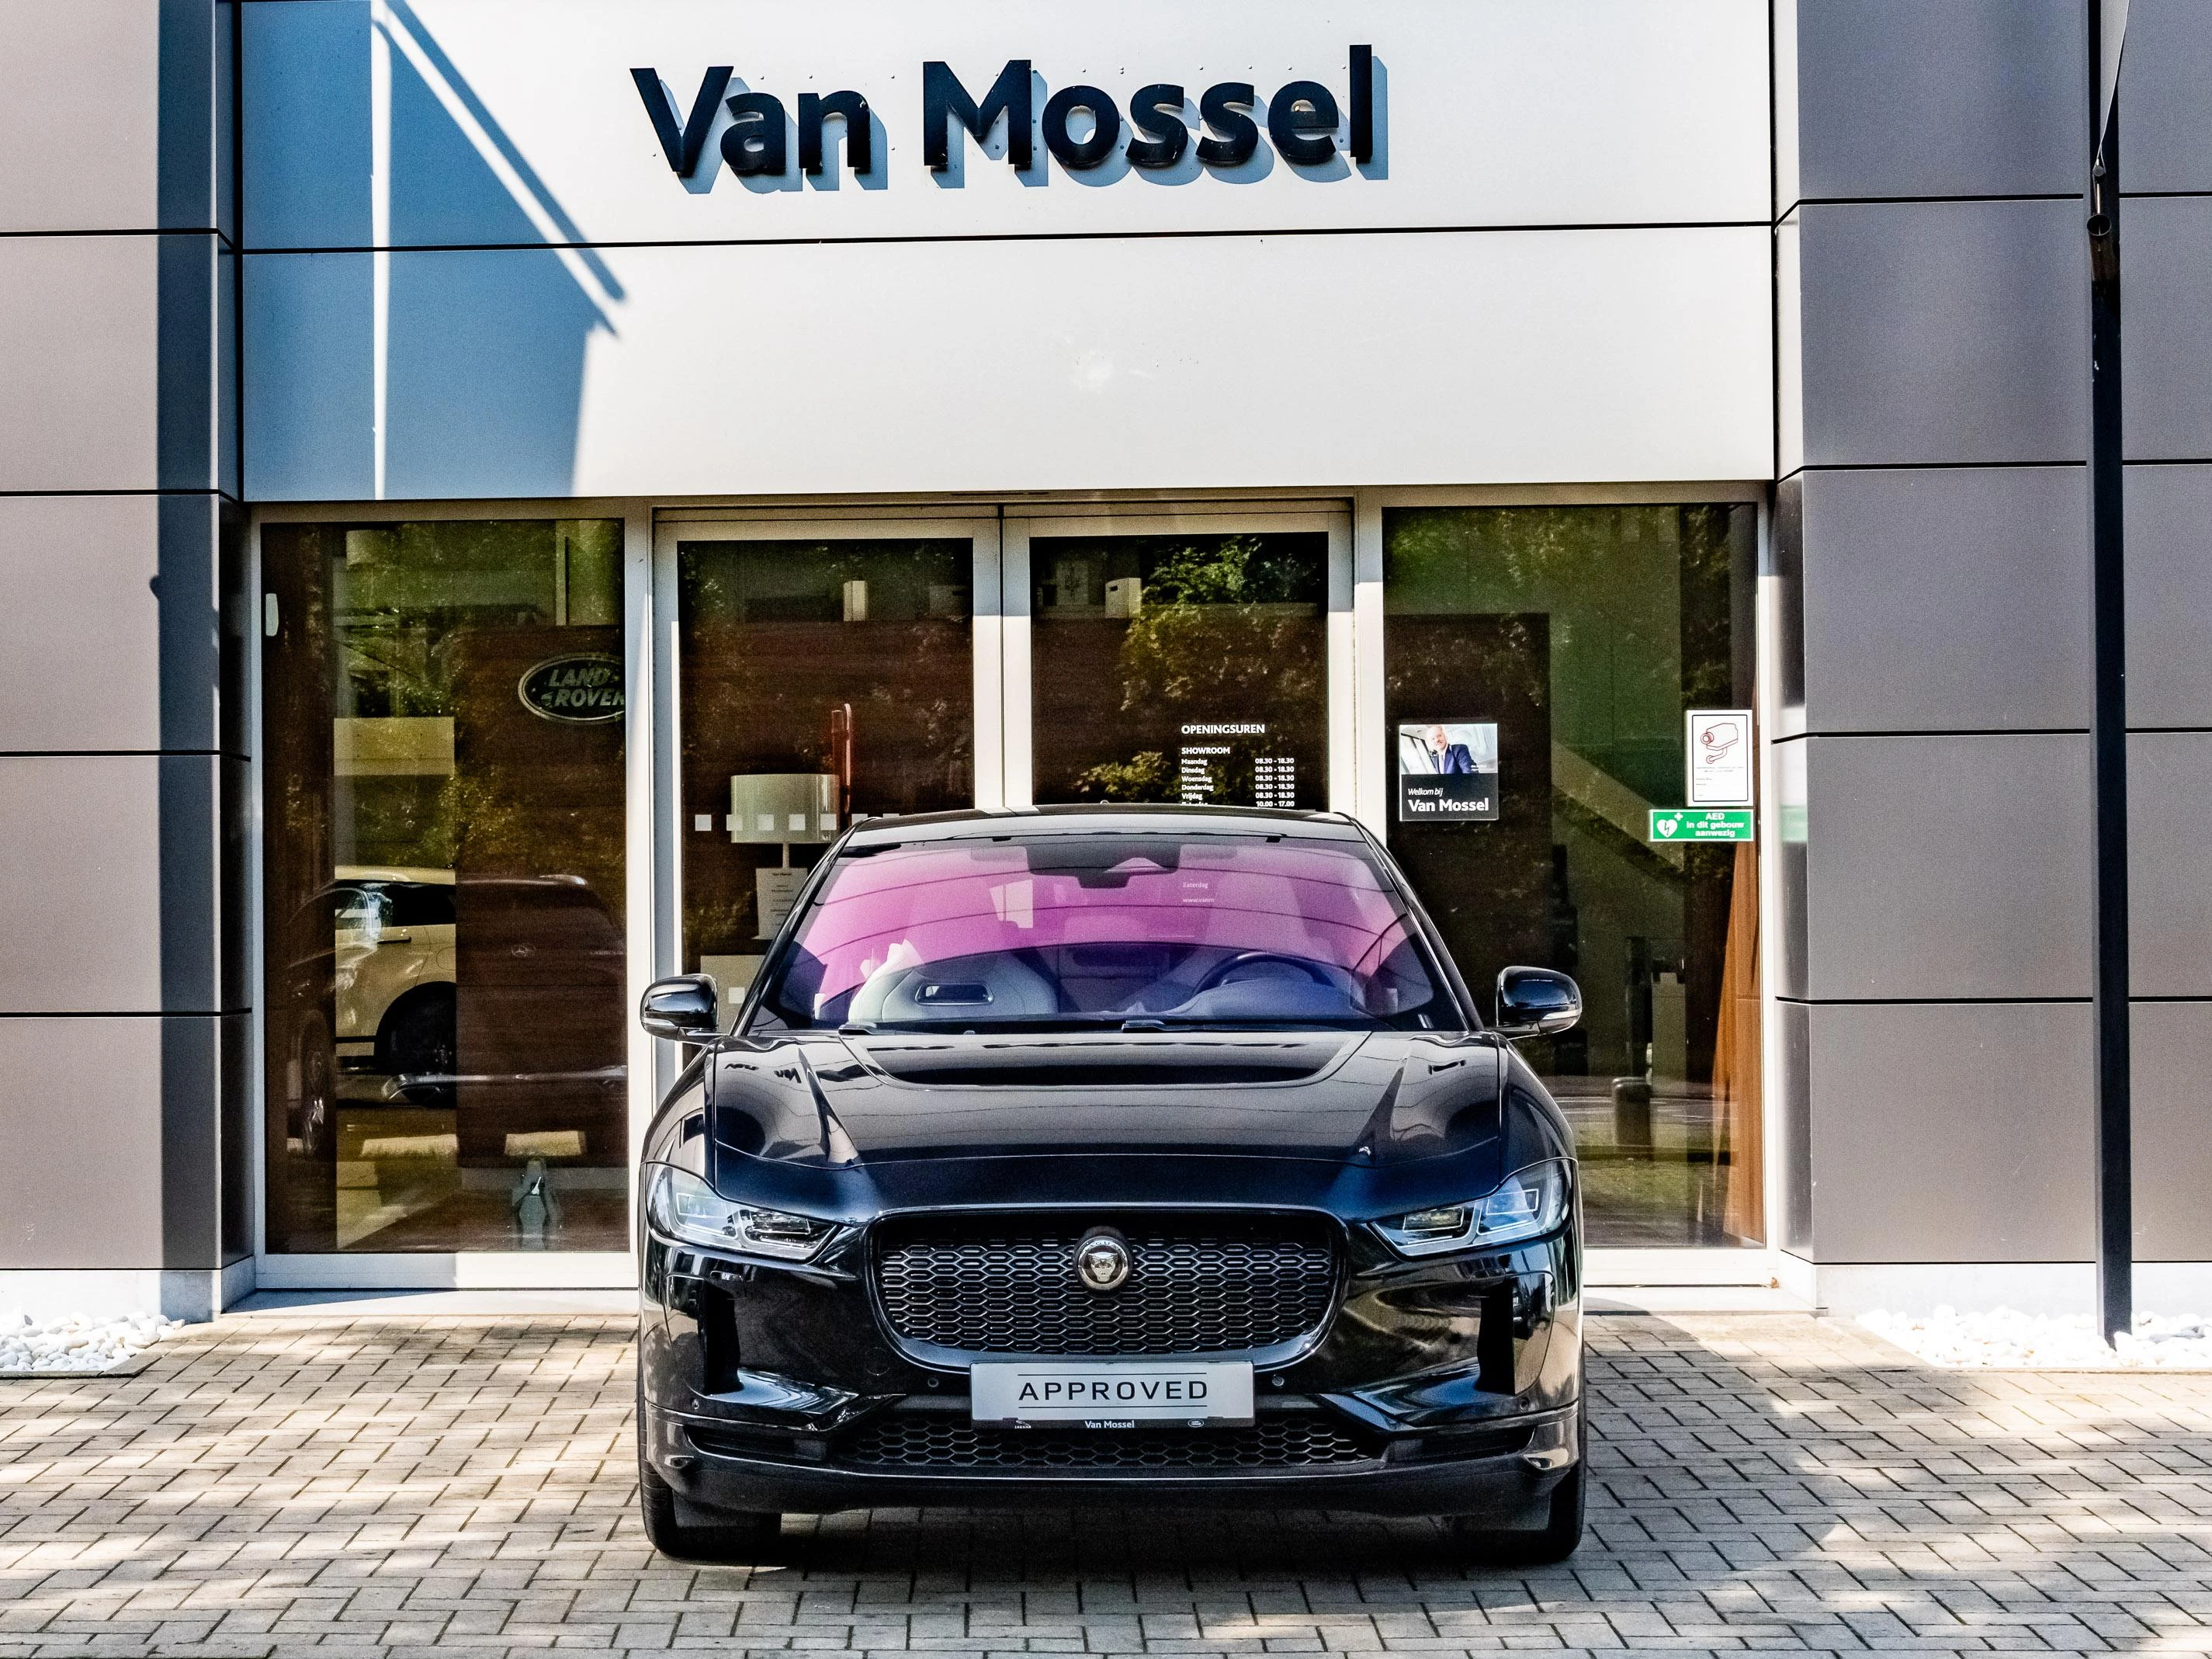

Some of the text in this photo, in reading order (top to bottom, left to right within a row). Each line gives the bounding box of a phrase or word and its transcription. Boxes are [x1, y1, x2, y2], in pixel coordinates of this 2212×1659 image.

[629, 44, 1374, 175] Van Mossel
[548, 668, 610, 686] LAND
[1181, 724, 1265, 734] OPENINGSUREN
[1181, 746, 1231, 755] SHOWROOM
[1434, 788, 1444, 797] bij
[1408, 797, 1489, 812] Van Mossel
[1710, 821, 1746, 831] gebouw
[1695, 828, 1736, 838] aanwezig
[1018, 1380, 1208, 1400] APPROVED
[1084, 1420, 1102, 1428] Van
[1104, 1420, 1135, 1428] Mossel
